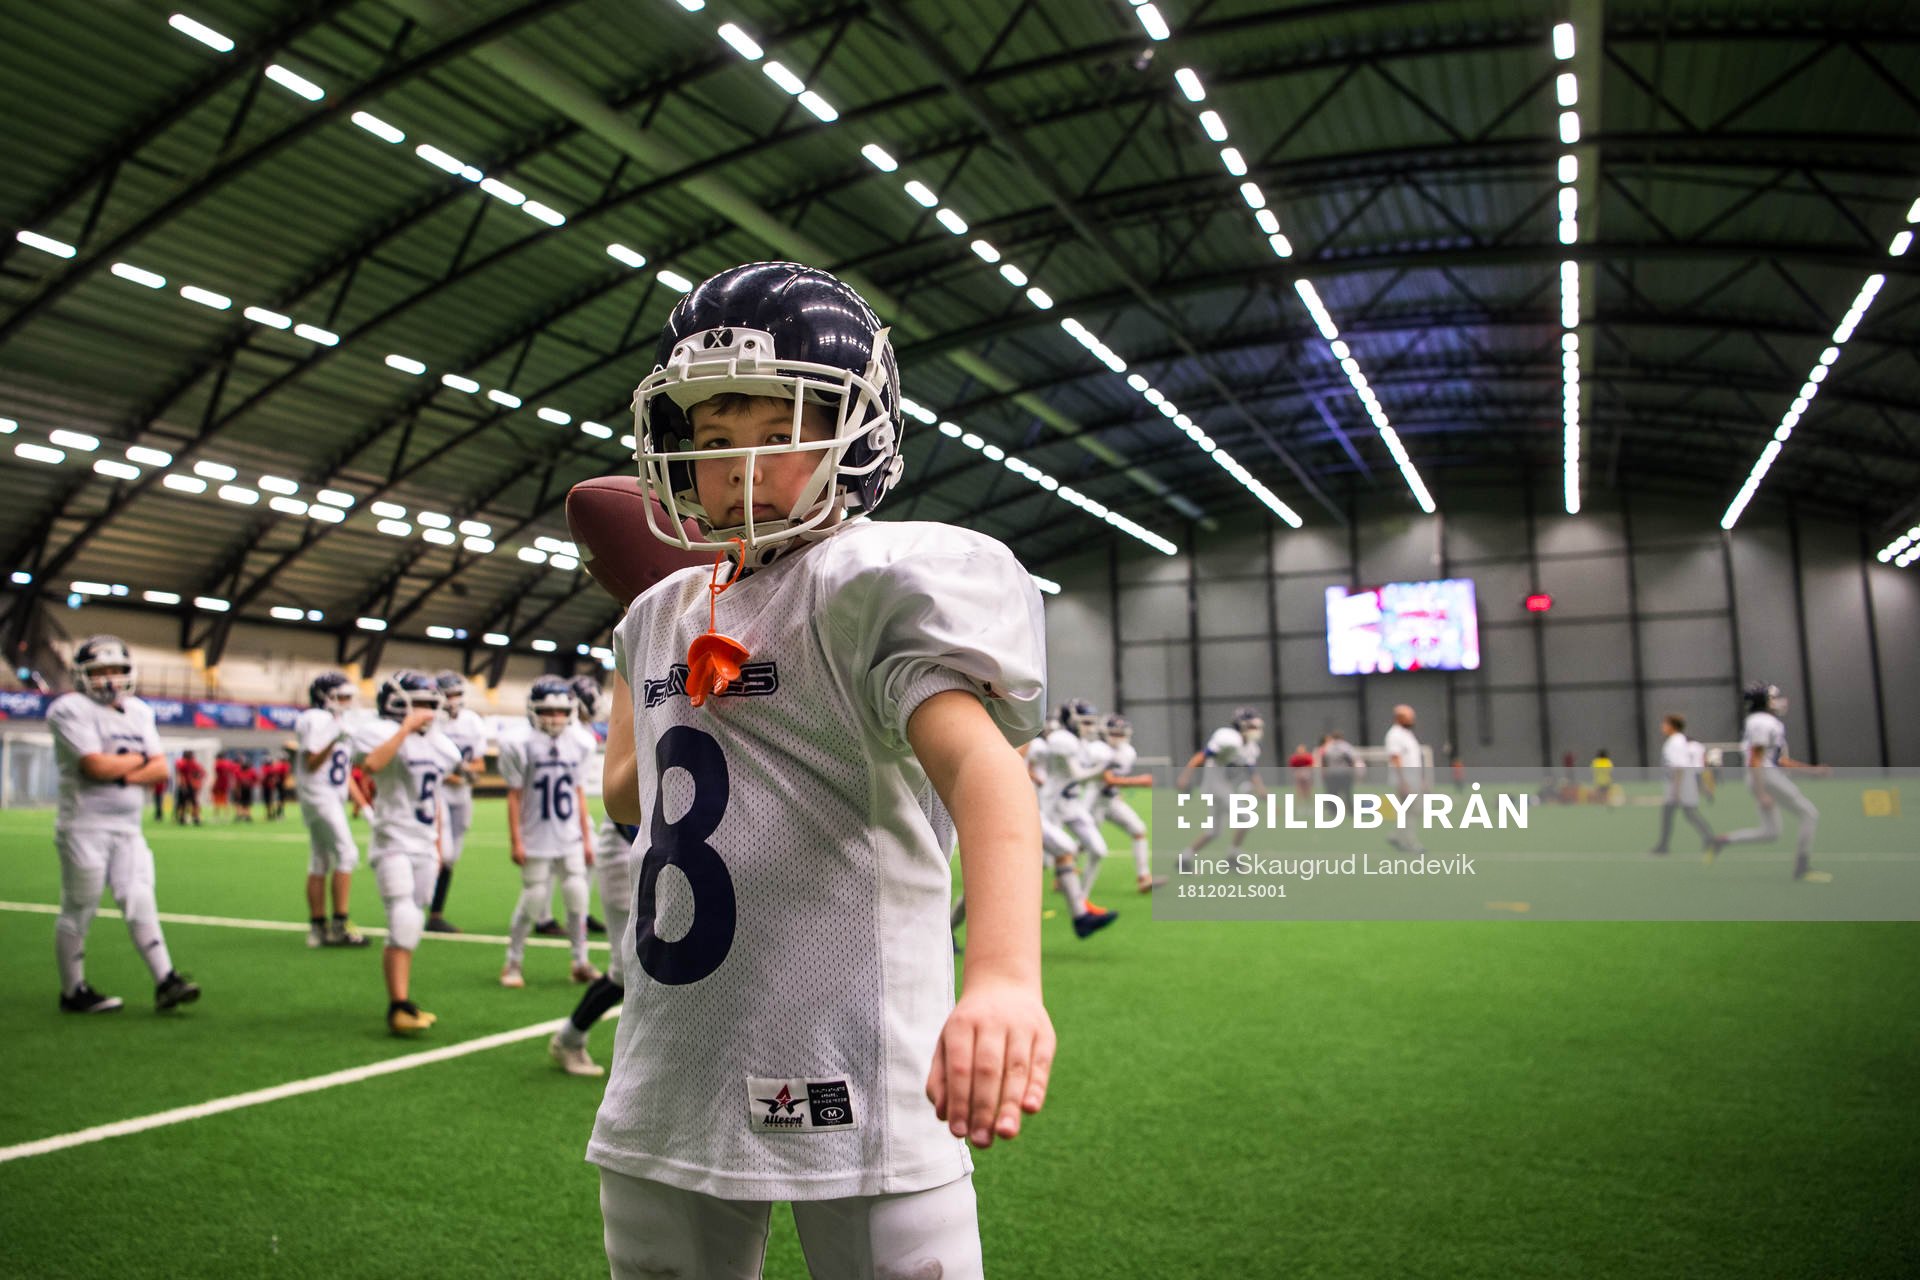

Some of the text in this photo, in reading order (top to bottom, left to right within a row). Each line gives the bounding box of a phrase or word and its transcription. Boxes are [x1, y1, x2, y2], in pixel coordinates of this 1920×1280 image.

[329, 750, 348, 786] 8
[533, 773, 573, 821] 16
[636, 725, 737, 986] 8
[827, 1109, 838, 1118] M
